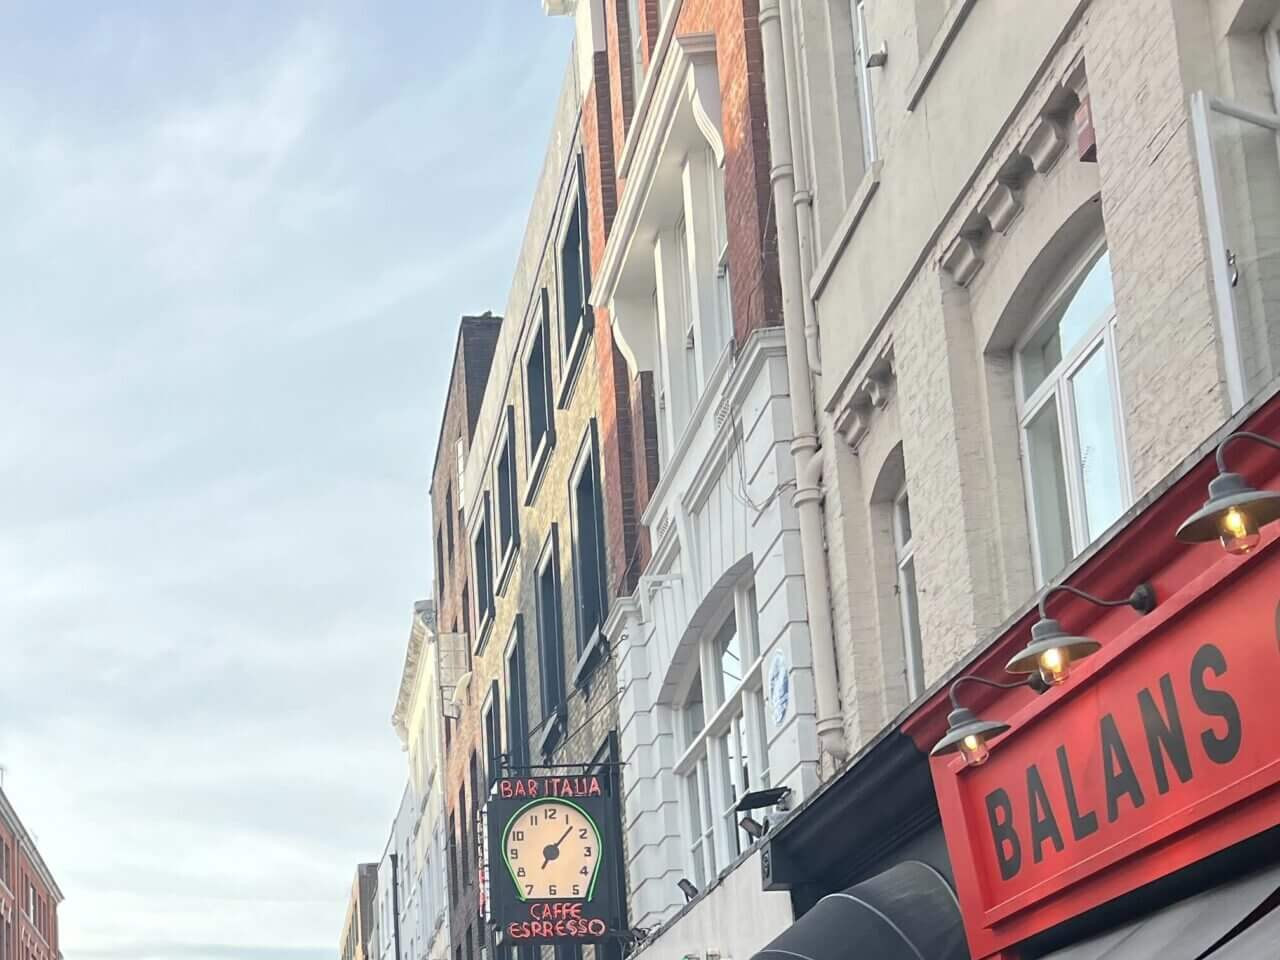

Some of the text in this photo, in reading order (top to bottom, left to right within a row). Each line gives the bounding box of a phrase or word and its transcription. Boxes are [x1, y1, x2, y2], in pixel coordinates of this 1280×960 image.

[985, 643, 1242, 881] BALANS
[500, 776, 601, 798] BAR ITALIA
[544, 808, 557, 820] 12
[565, 814, 569, 825] 1
[530, 815, 538, 826] 11
[512, 831, 524, 842] 10
[579, 828, 588, 840] 2
[510, 849, 519, 860] 9
[583, 847, 592, 857] 3
[517, 867, 526, 877] 8
[579, 865, 589, 876] 4
[525, 884, 534, 895] 7
[548, 884, 557, 895] 6
[572, 884, 580, 895] 5
[530, 903, 583, 920] CAFFE
[510, 919, 606, 938] ESPRESSO
